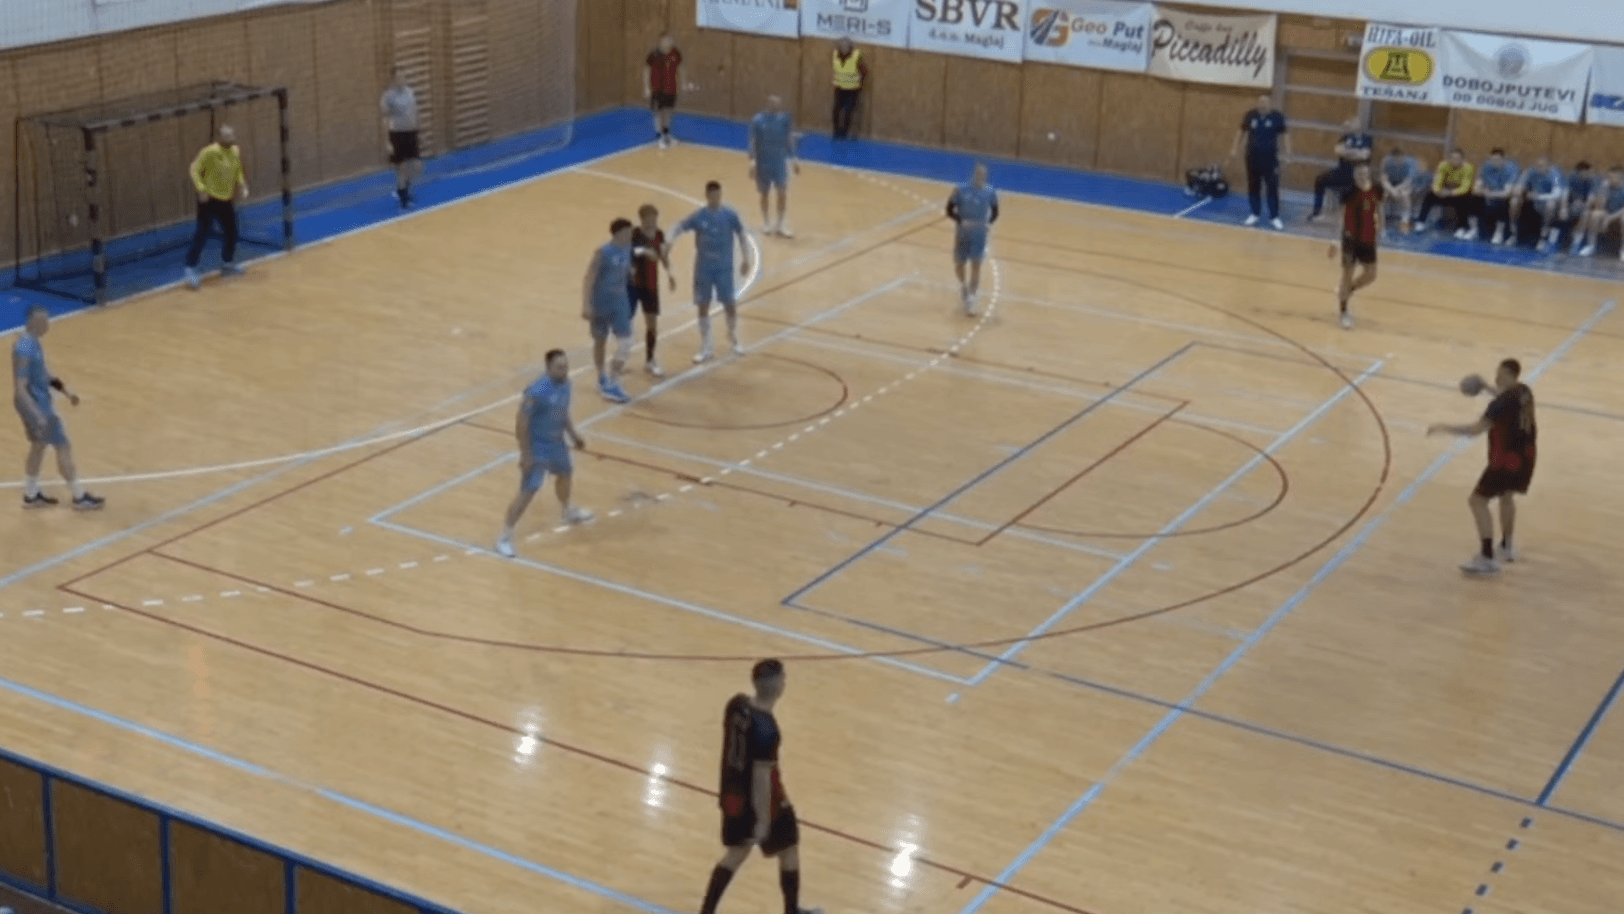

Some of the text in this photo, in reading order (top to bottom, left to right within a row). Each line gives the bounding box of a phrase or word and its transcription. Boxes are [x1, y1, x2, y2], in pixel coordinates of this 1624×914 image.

[816, 12, 892, 35] MERI-S
[915, 0, 1020, 31] SBVR
[1071, 17, 1144, 39] Geo Put
[965, 33, 1005, 49] Maglaj
[1152, 19, 1267, 78] Piccadilly
[1442, 75, 1576, 101] DOBOJPUTEVI
